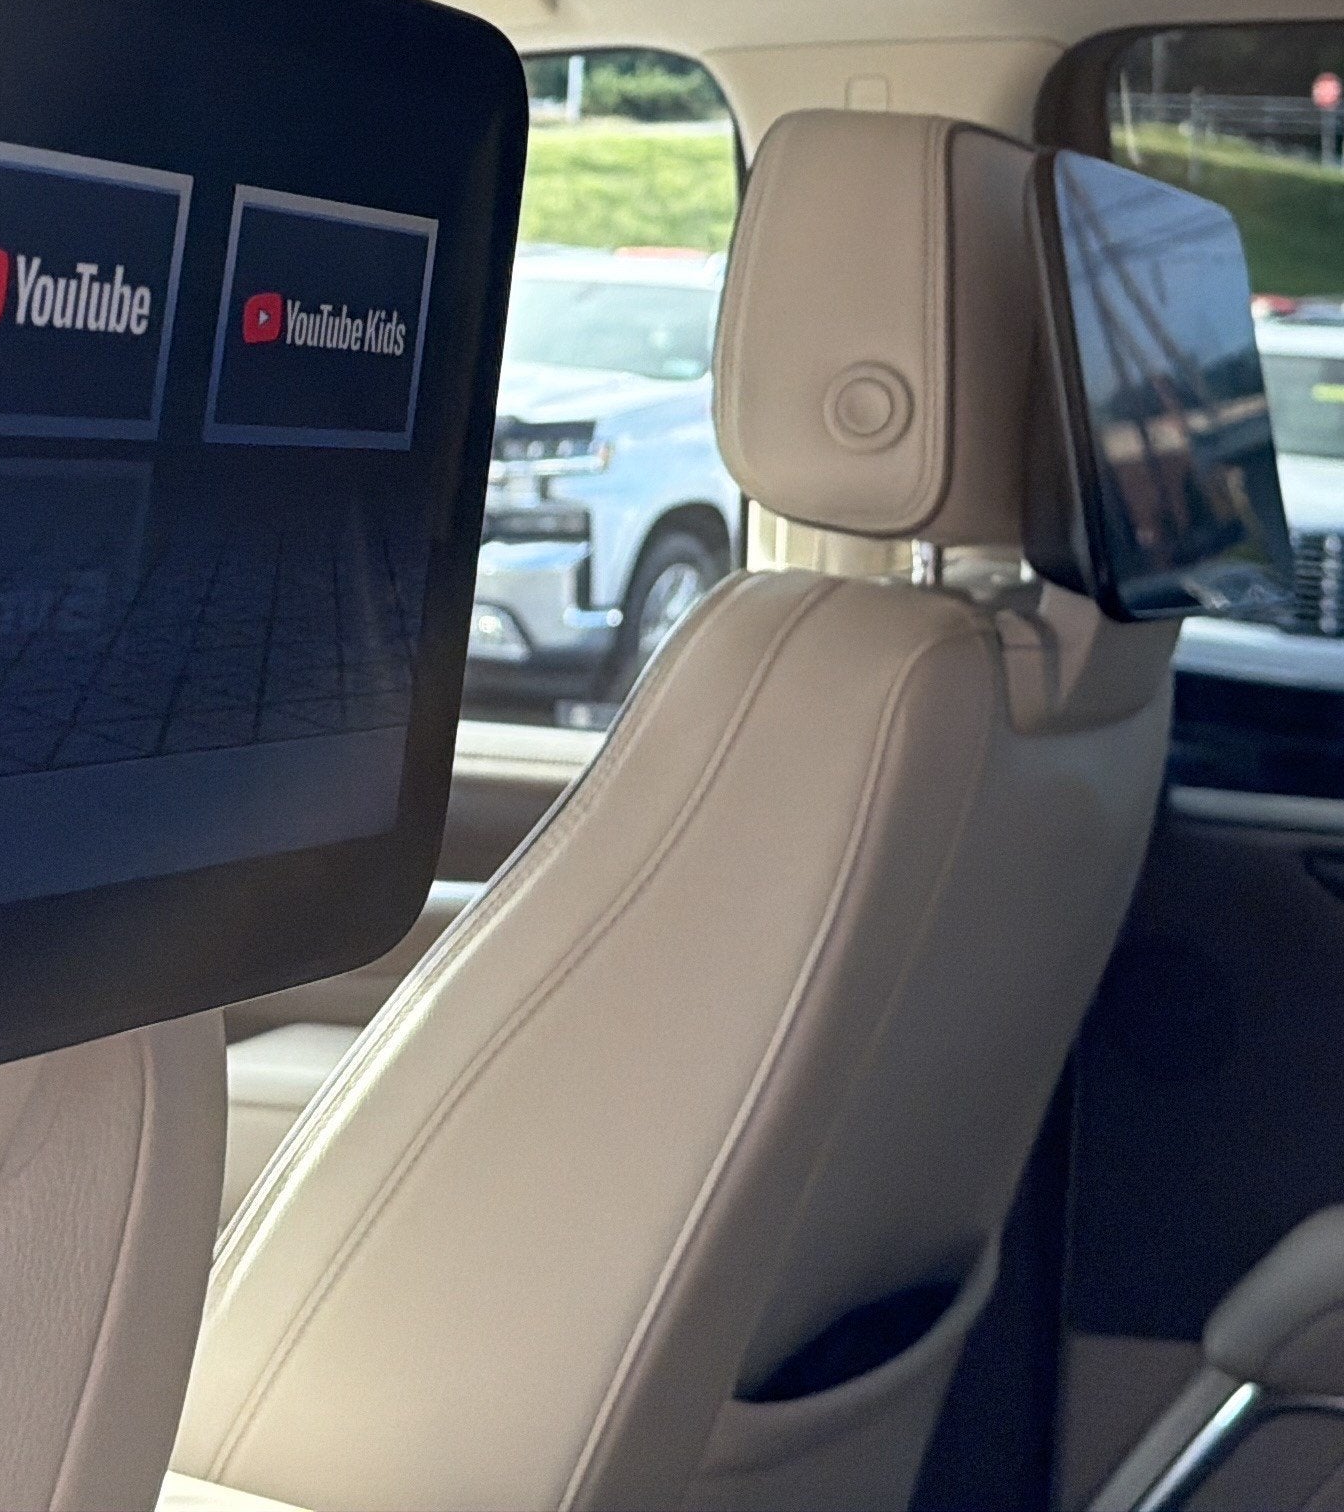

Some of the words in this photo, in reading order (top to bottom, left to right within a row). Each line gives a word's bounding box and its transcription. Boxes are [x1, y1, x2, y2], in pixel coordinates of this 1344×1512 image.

[15, 253, 151, 335] YouTube
[285, 299, 363, 351] YouTube
[363, 308, 406, 356] Kids
